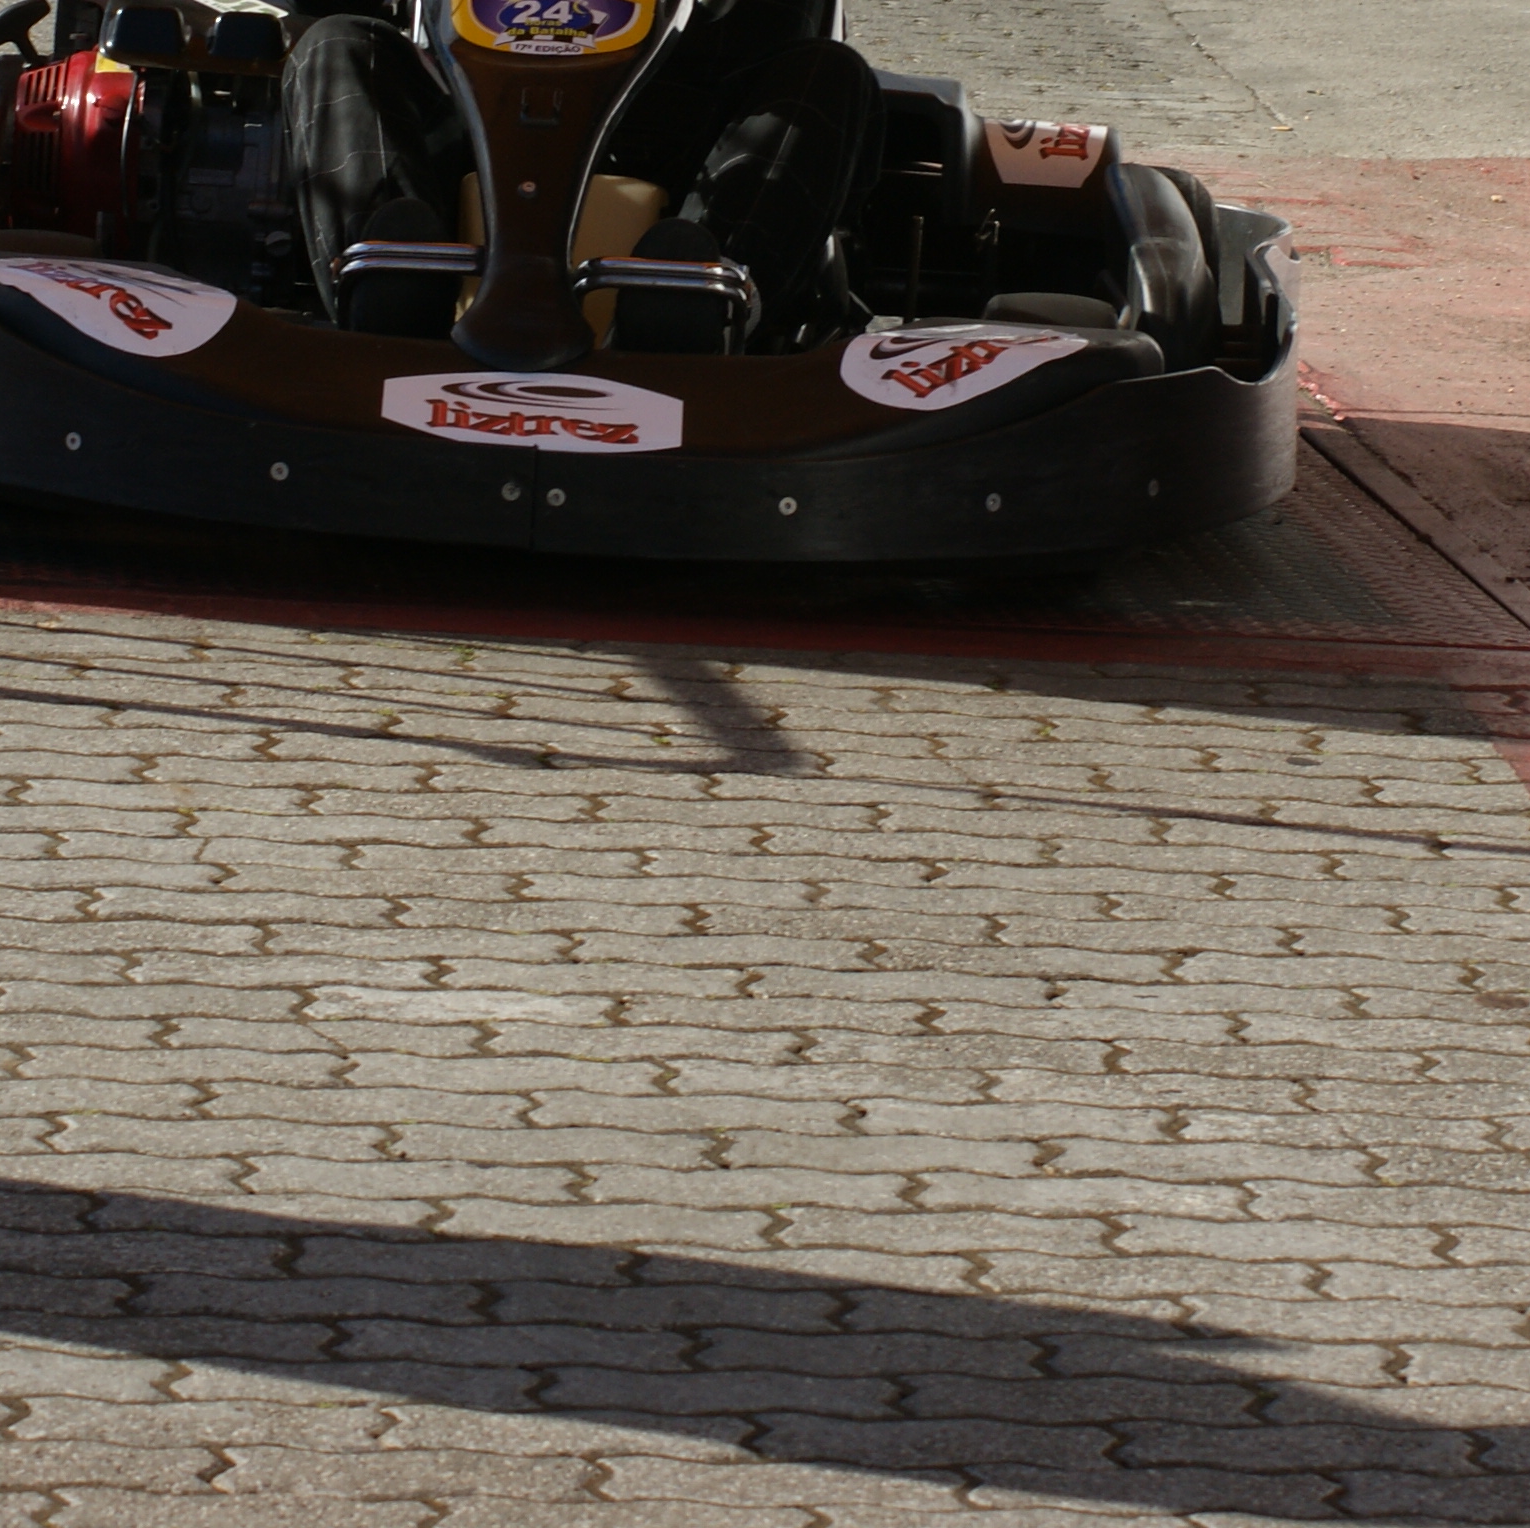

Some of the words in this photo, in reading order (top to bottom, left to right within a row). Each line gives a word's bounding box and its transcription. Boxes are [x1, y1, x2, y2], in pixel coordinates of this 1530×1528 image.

[511, 0, 574, 25] 24
[507, 25, 526, 36] da
[529, 25, 588, 38] Batalha
[534, 43, 582, 55] EDIÇÃO
[424, 398, 640, 444] liztrez
